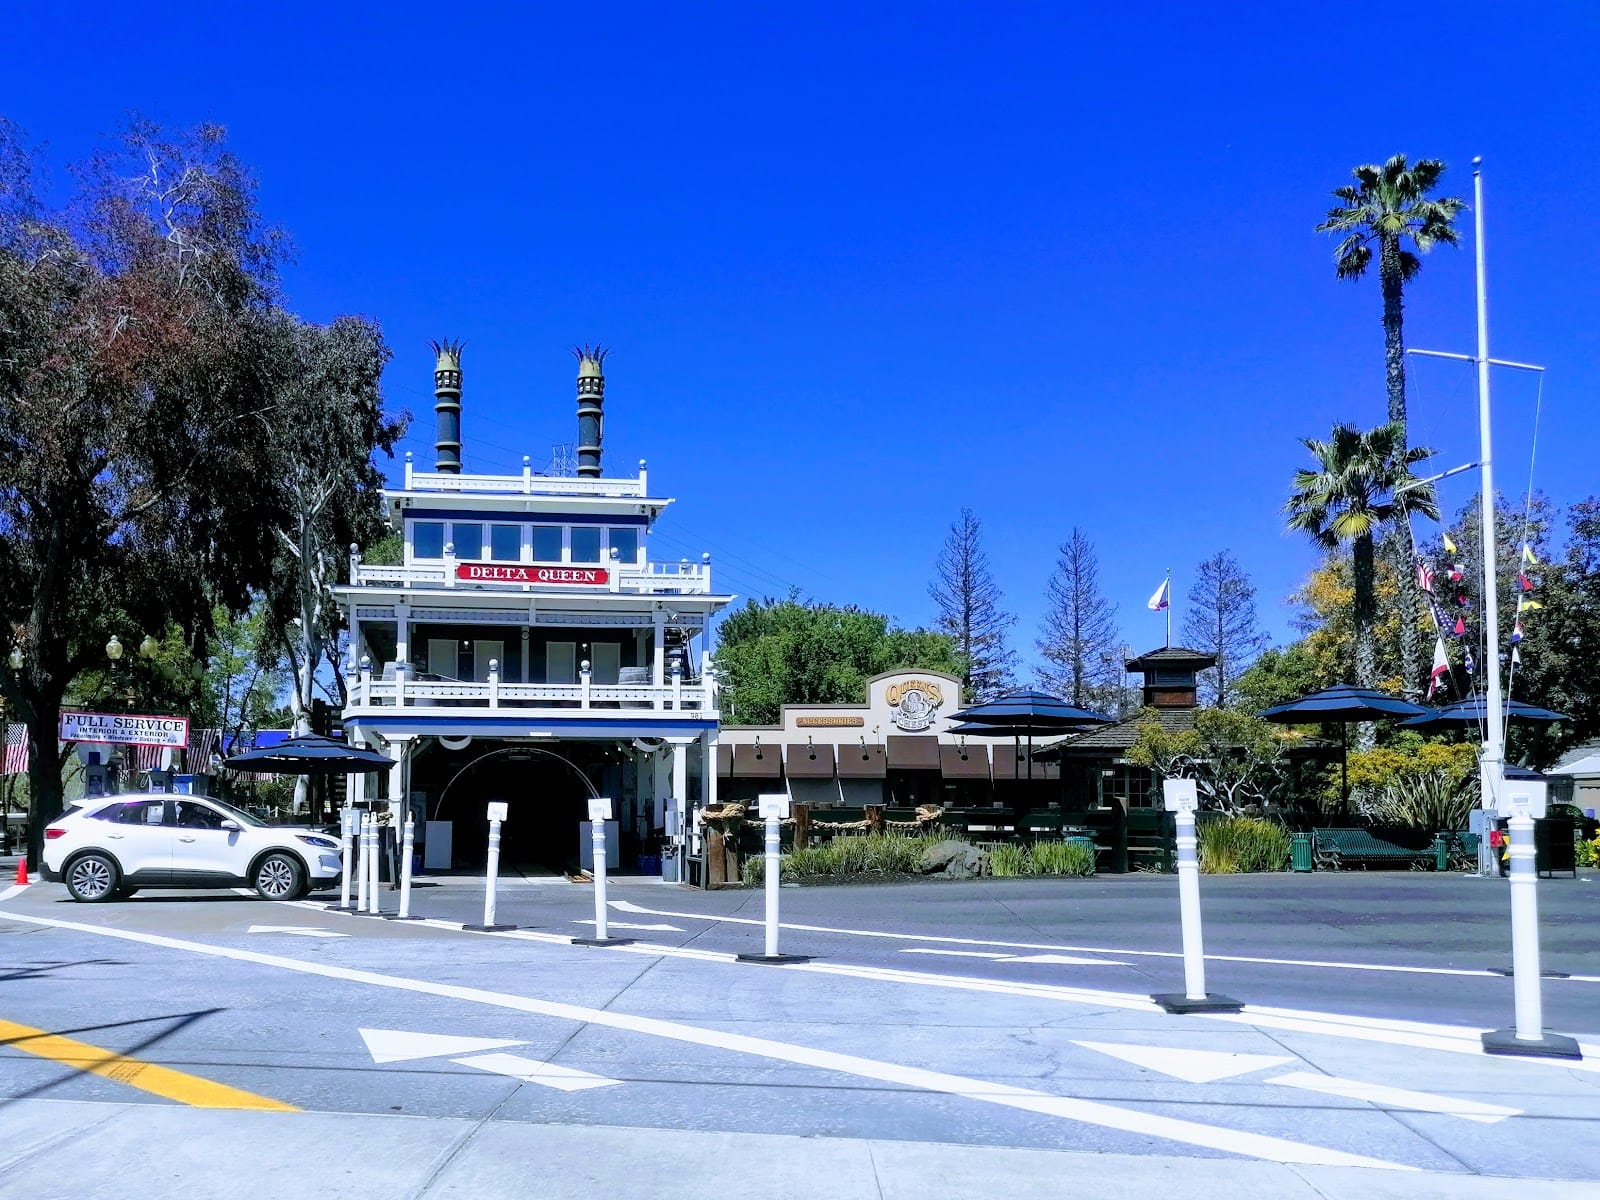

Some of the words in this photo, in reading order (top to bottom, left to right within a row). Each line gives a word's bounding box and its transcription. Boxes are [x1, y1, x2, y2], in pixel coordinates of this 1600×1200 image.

[469, 566, 529, 580] DELTA
[538, 569, 597, 582] QUEEN
[64, 714, 108, 728] FULL
[113, 717, 184, 732] SERVICE
[79, 727, 118, 735] INTERIOR
[128, 730, 169, 738] EXTERIOR
